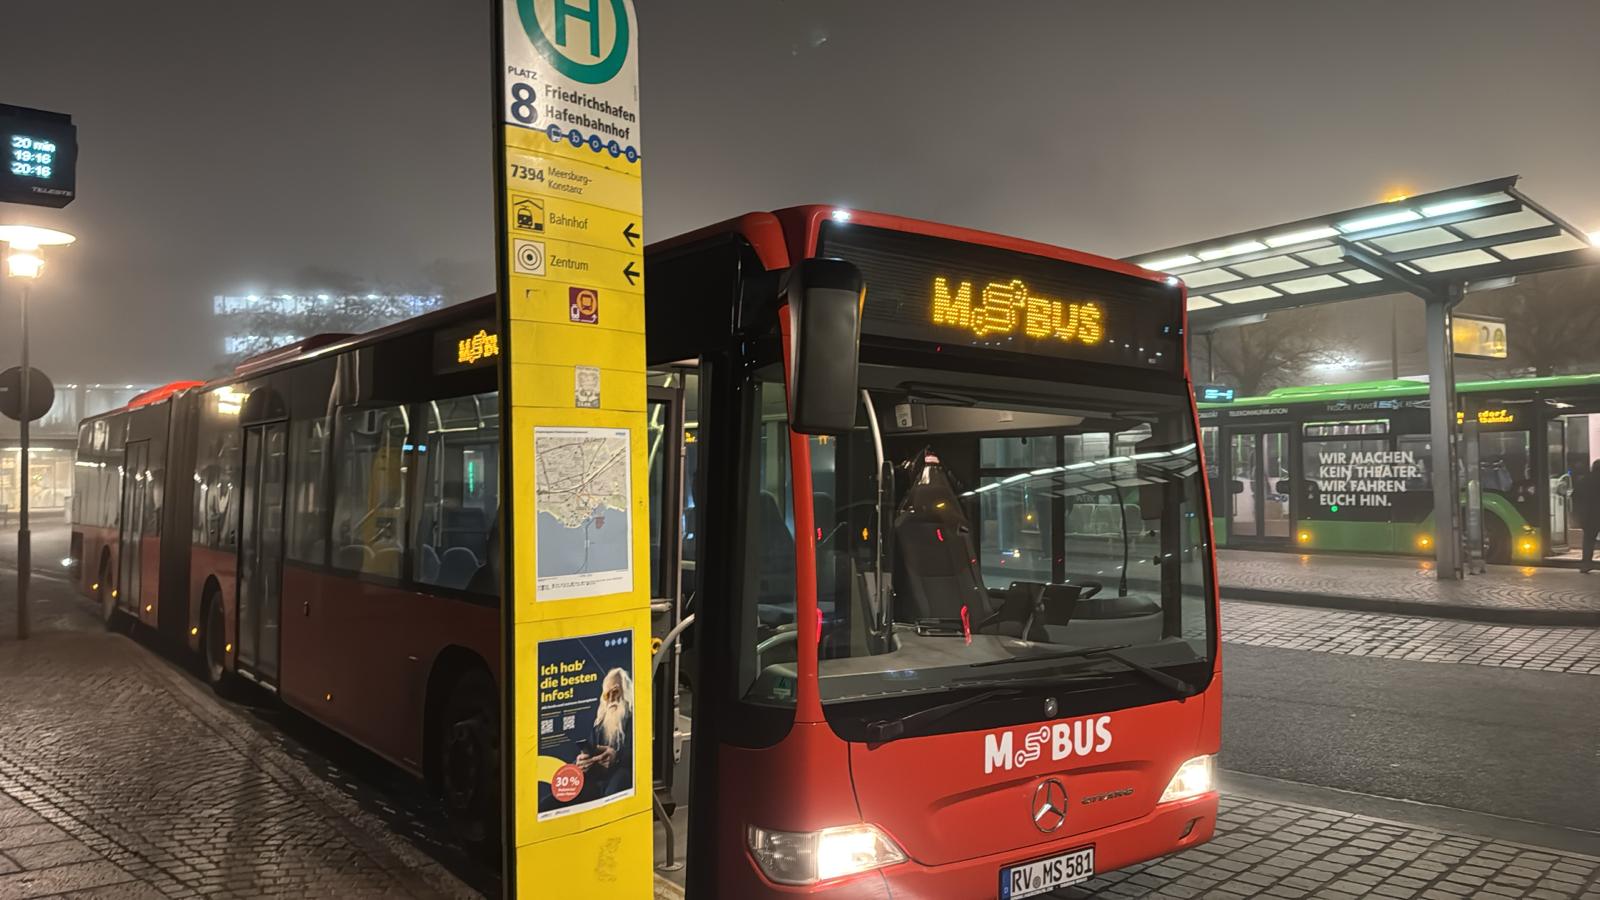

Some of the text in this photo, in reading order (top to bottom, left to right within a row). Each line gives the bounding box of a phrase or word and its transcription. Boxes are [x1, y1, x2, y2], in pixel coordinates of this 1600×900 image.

[555, 0, 600, 58] H
[508, 65, 538, 81] PLATZ
[510, 82, 539, 125] 8
[544, 84, 636, 123] Friedrichshafen
[545, 104, 630, 140] Hafenbahnhof
[12, 135, 56, 153] 20 min
[510, 164, 545, 183] 7394
[547, 166, 592, 186] Meersburg-
[547, 180, 583, 195] Konstanz
[549, 212, 589, 230] Bahnhof
[549, 254, 589, 272] Zentrum
[1319, 451, 1414, 465] WIR MACHEN
[1319, 465, 1422, 478] KEIN THEATER.
[1319, 480, 1406, 493] WIR FAHREN
[1319, 493, 1392, 507] EUCH HIN.
[541, 664, 558, 676] Ich
[540, 673, 598, 690] die besten
[541, 687, 575, 703] Infos!
[555, 776, 580, 787] 30 %
[1012, 866, 1033, 893] RV
[1043, 859, 1063, 886] MS
[1066, 852, 1093, 879] 581
